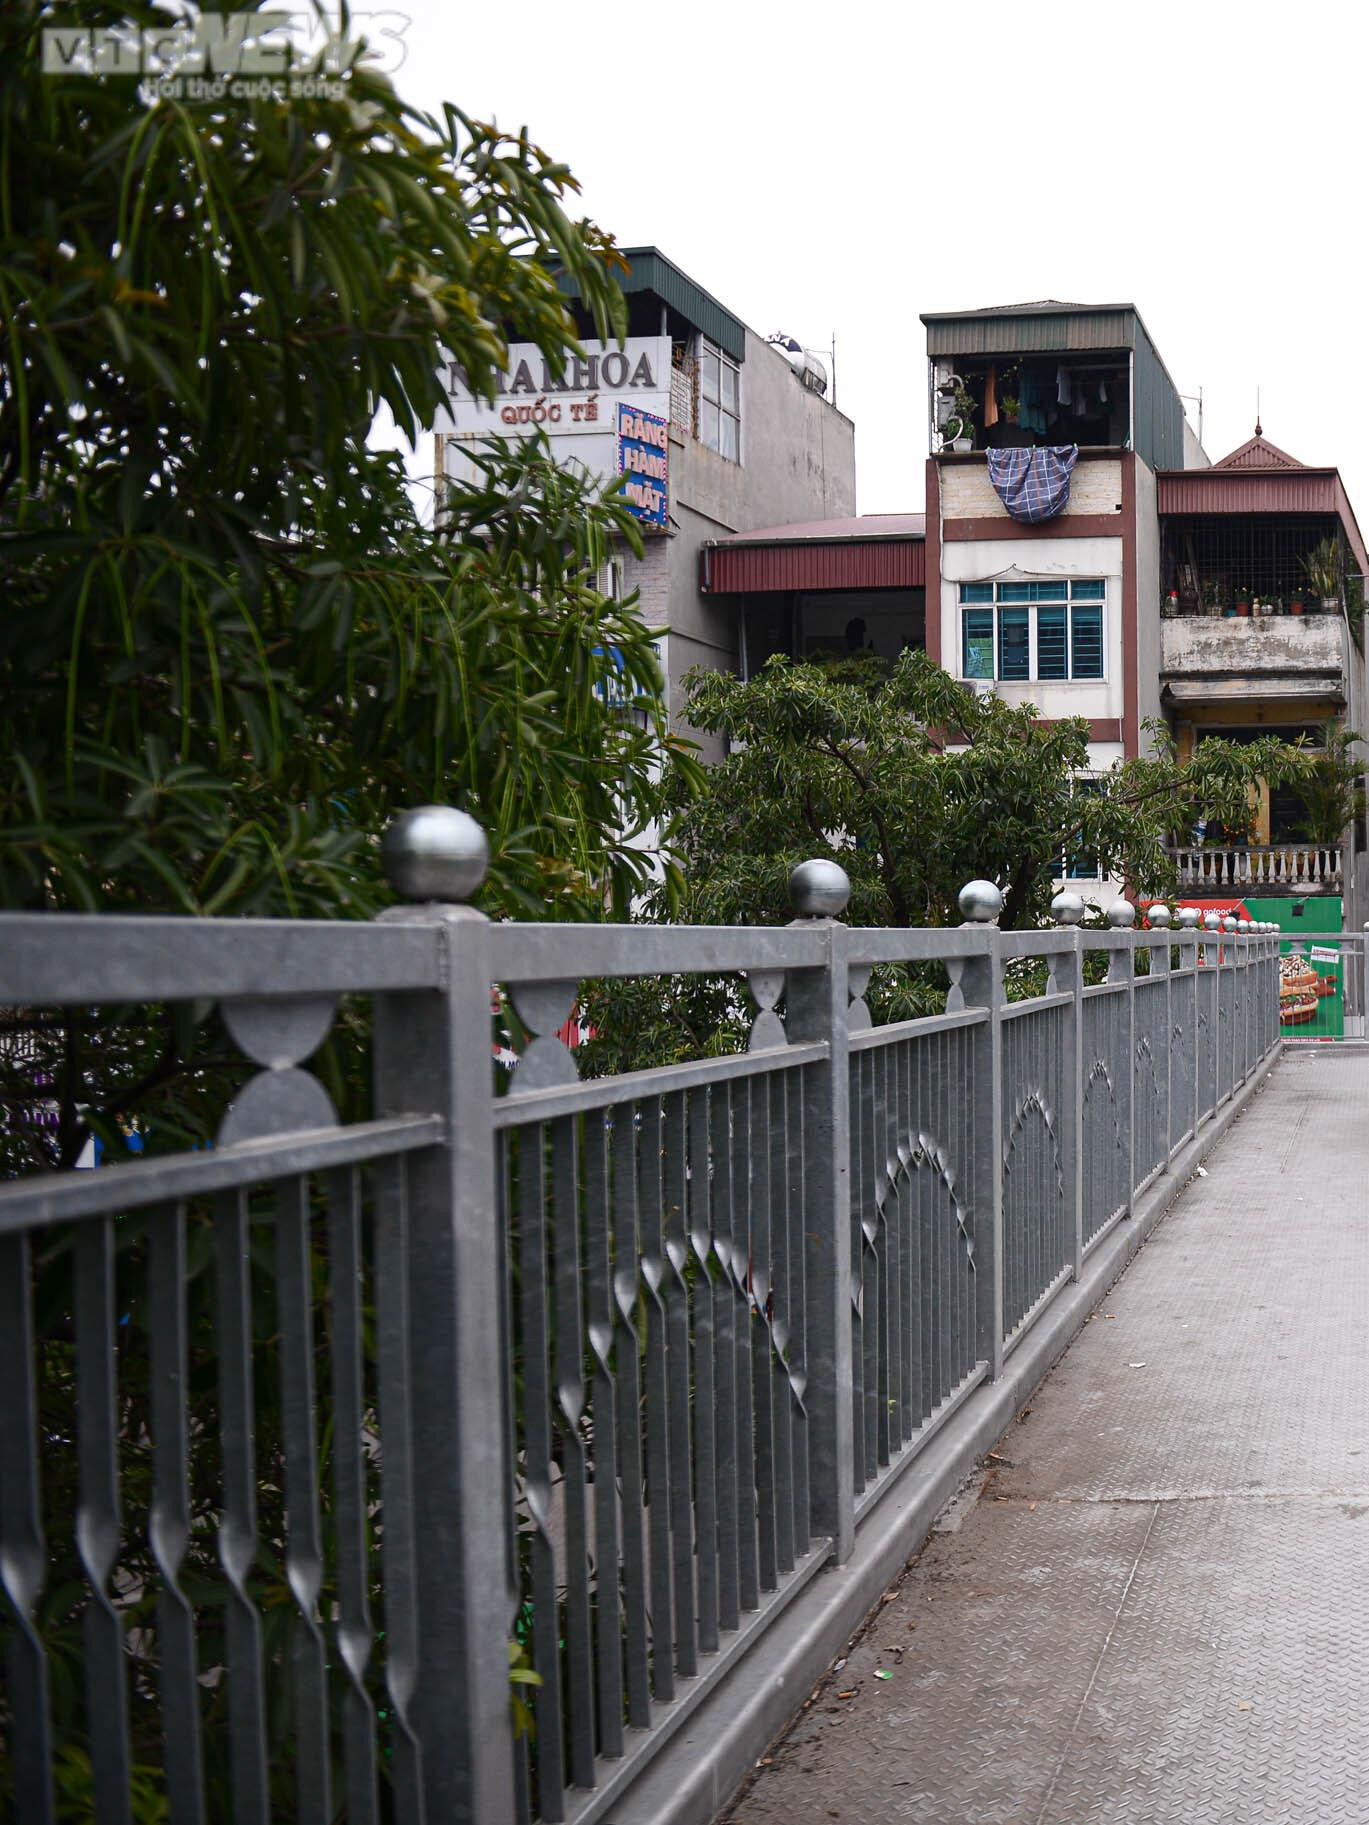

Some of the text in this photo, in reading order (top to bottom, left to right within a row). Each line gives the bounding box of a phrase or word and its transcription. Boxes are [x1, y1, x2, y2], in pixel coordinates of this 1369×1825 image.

[501, 394, 599, 425] QUỐC TẾ
[621, 412, 668, 449] RĂNG
[626, 480, 663, 515] MẶT
